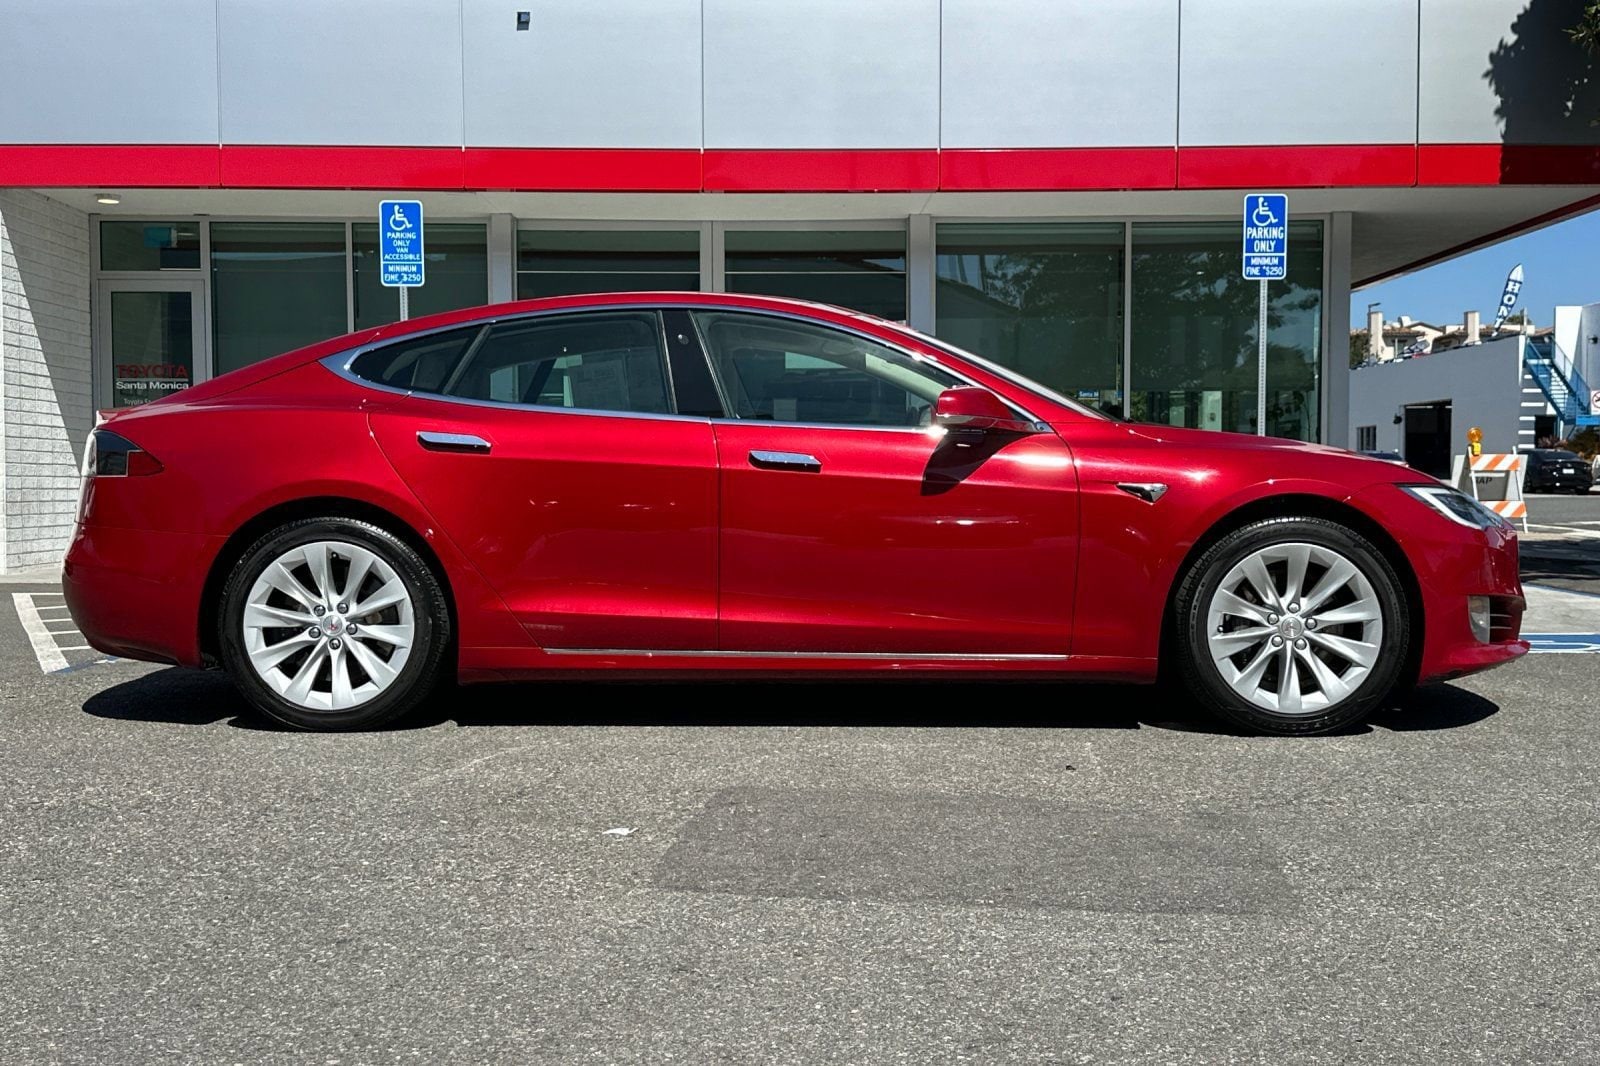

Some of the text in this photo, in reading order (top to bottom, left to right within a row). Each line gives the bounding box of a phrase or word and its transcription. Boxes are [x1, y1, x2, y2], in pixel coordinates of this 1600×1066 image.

[1247, 227, 1284, 239] PARKING
[1254, 240, 1276, 252] ONLY
[1251, 257, 1279, 265] MINIMUM
[1246, 266, 1261, 276] FINE
[116, 364, 189, 378] TOYOTA
[116, 381, 189, 390] Santa Monica
[123, 398, 144, 406] Toyota
